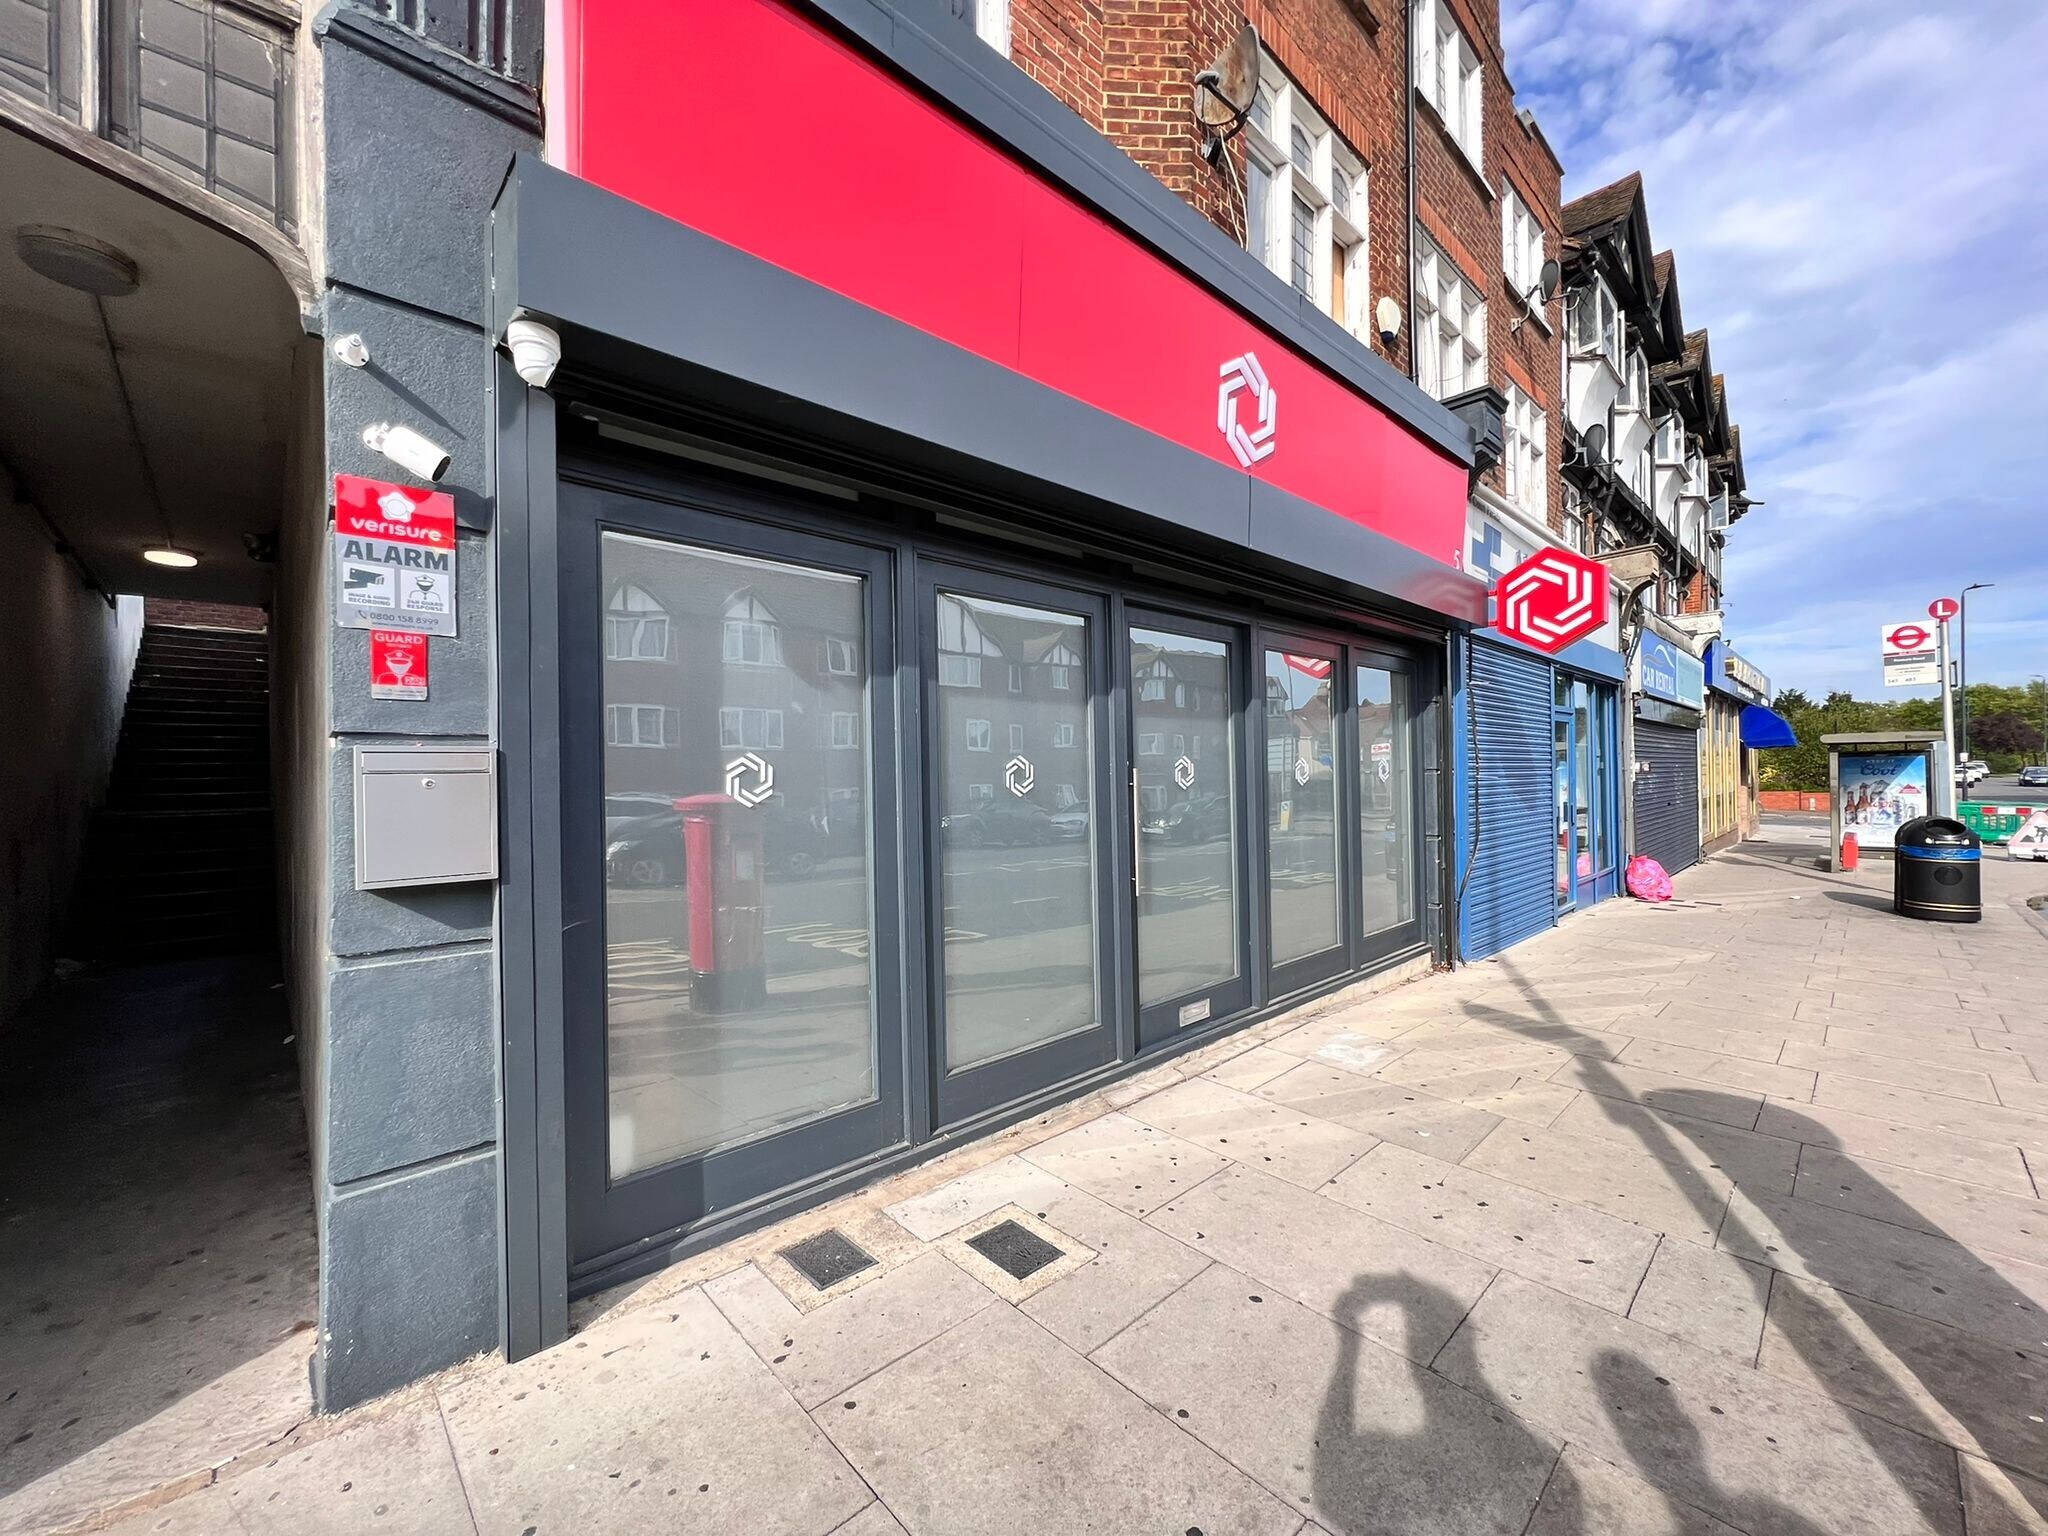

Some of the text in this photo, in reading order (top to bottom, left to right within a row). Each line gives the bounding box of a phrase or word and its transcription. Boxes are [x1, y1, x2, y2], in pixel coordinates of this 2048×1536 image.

[350, 517, 442, 542] verisure
[344, 540, 449, 571] ALARM
[348, 597, 391, 606] RECORDING
[407, 604, 444, 612] RESPONSE
[1936, 601, 1951, 617] L
[370, 612, 439, 625] 0800 158 8999
[374, 632, 423, 645] GUARD
[1642, 664, 1675, 696] CAR RENTAL
